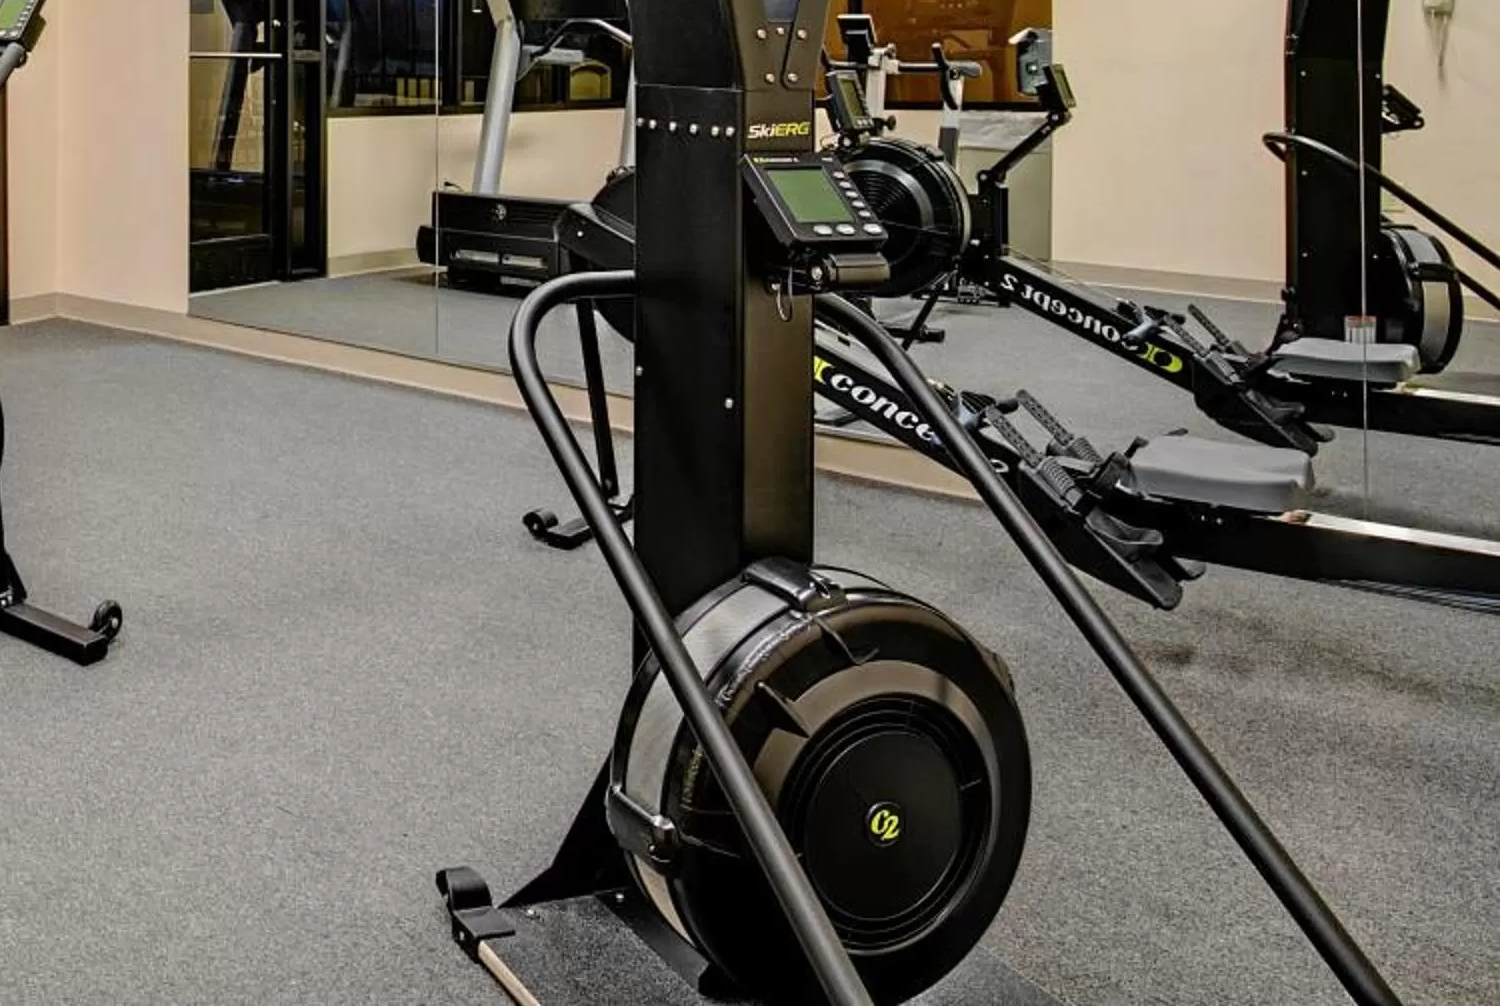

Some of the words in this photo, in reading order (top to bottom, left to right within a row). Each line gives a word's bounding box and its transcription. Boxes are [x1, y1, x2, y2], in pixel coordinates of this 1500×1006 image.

[747, 121, 811, 140] SkiERG
[829, 373, 936, 442] conce
[870, 809, 901, 841] C2
